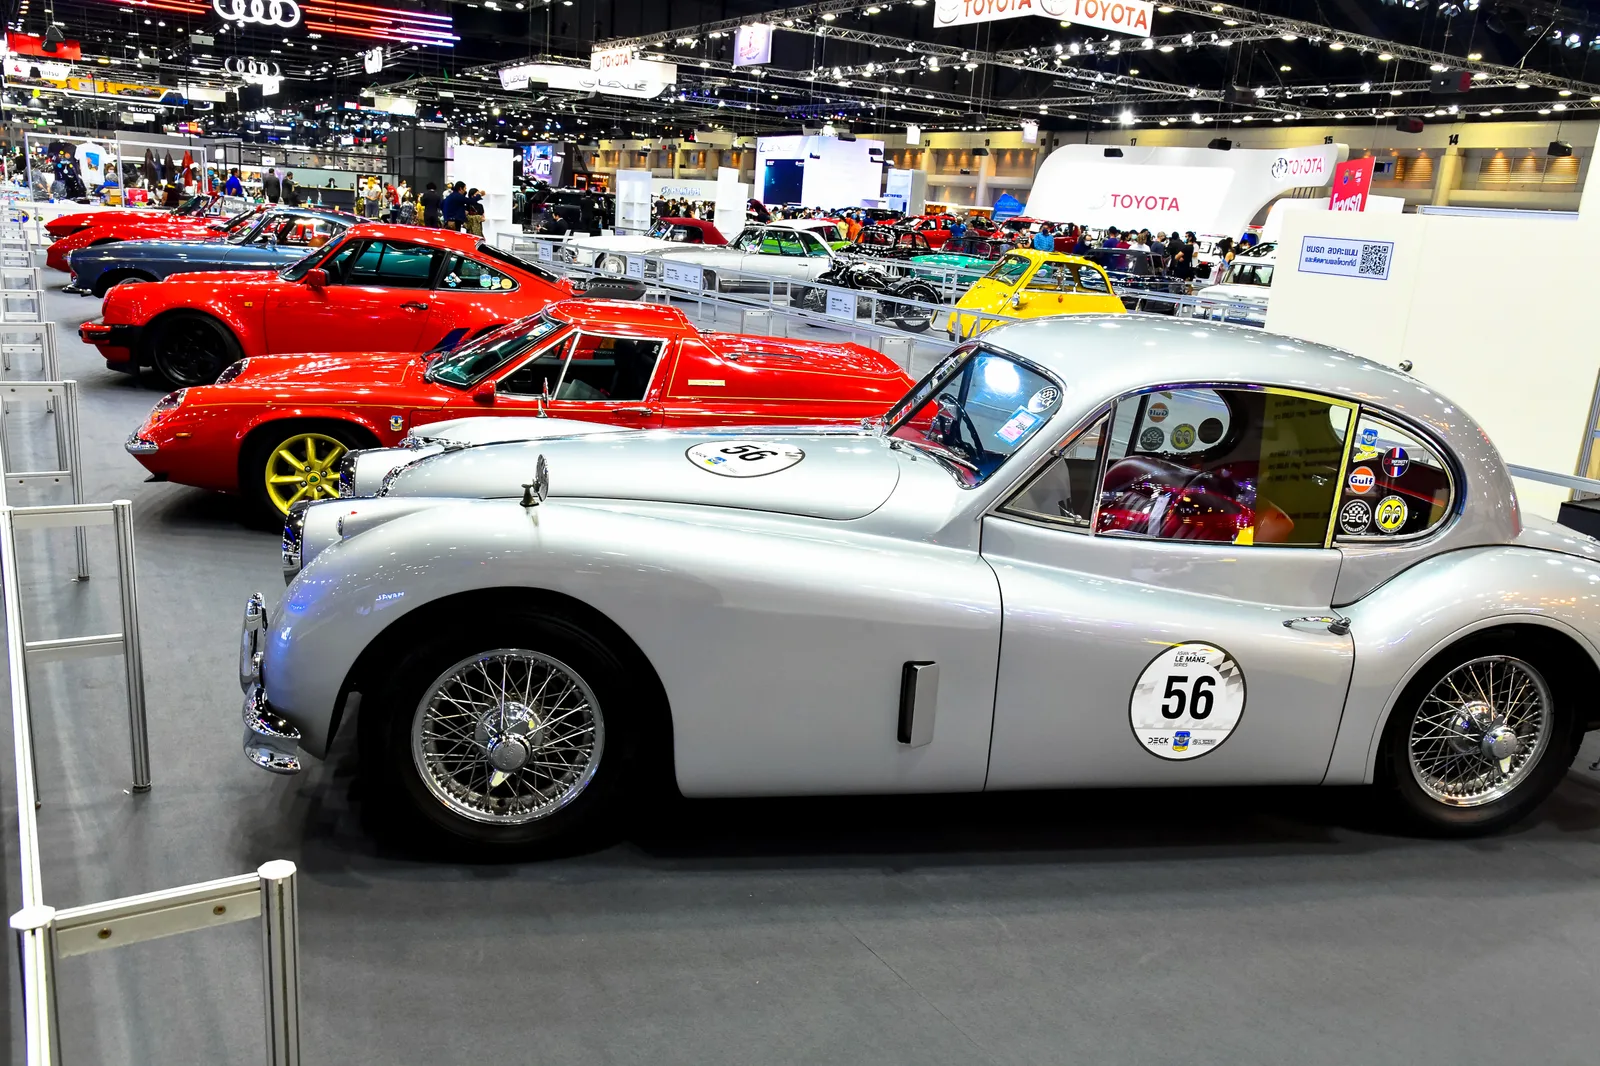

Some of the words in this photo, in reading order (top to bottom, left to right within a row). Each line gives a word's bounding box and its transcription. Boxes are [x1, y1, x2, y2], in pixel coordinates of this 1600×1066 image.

[1075, 0, 1147, 30] TOYOTA
[602, 53, 628, 68] TOYOTA
[1324, 136, 1333, 145] 15
[1448, 134, 1459, 146] 14
[1287, 158, 1323, 174] TOYOTA
[1111, 194, 1180, 211] TOYOTA
[720, 444, 779, 462] 56
[1351, 476, 1373, 485] Gulf
[1343, 513, 1369, 523] DECK
[1161, 675, 1216, 720] 56
